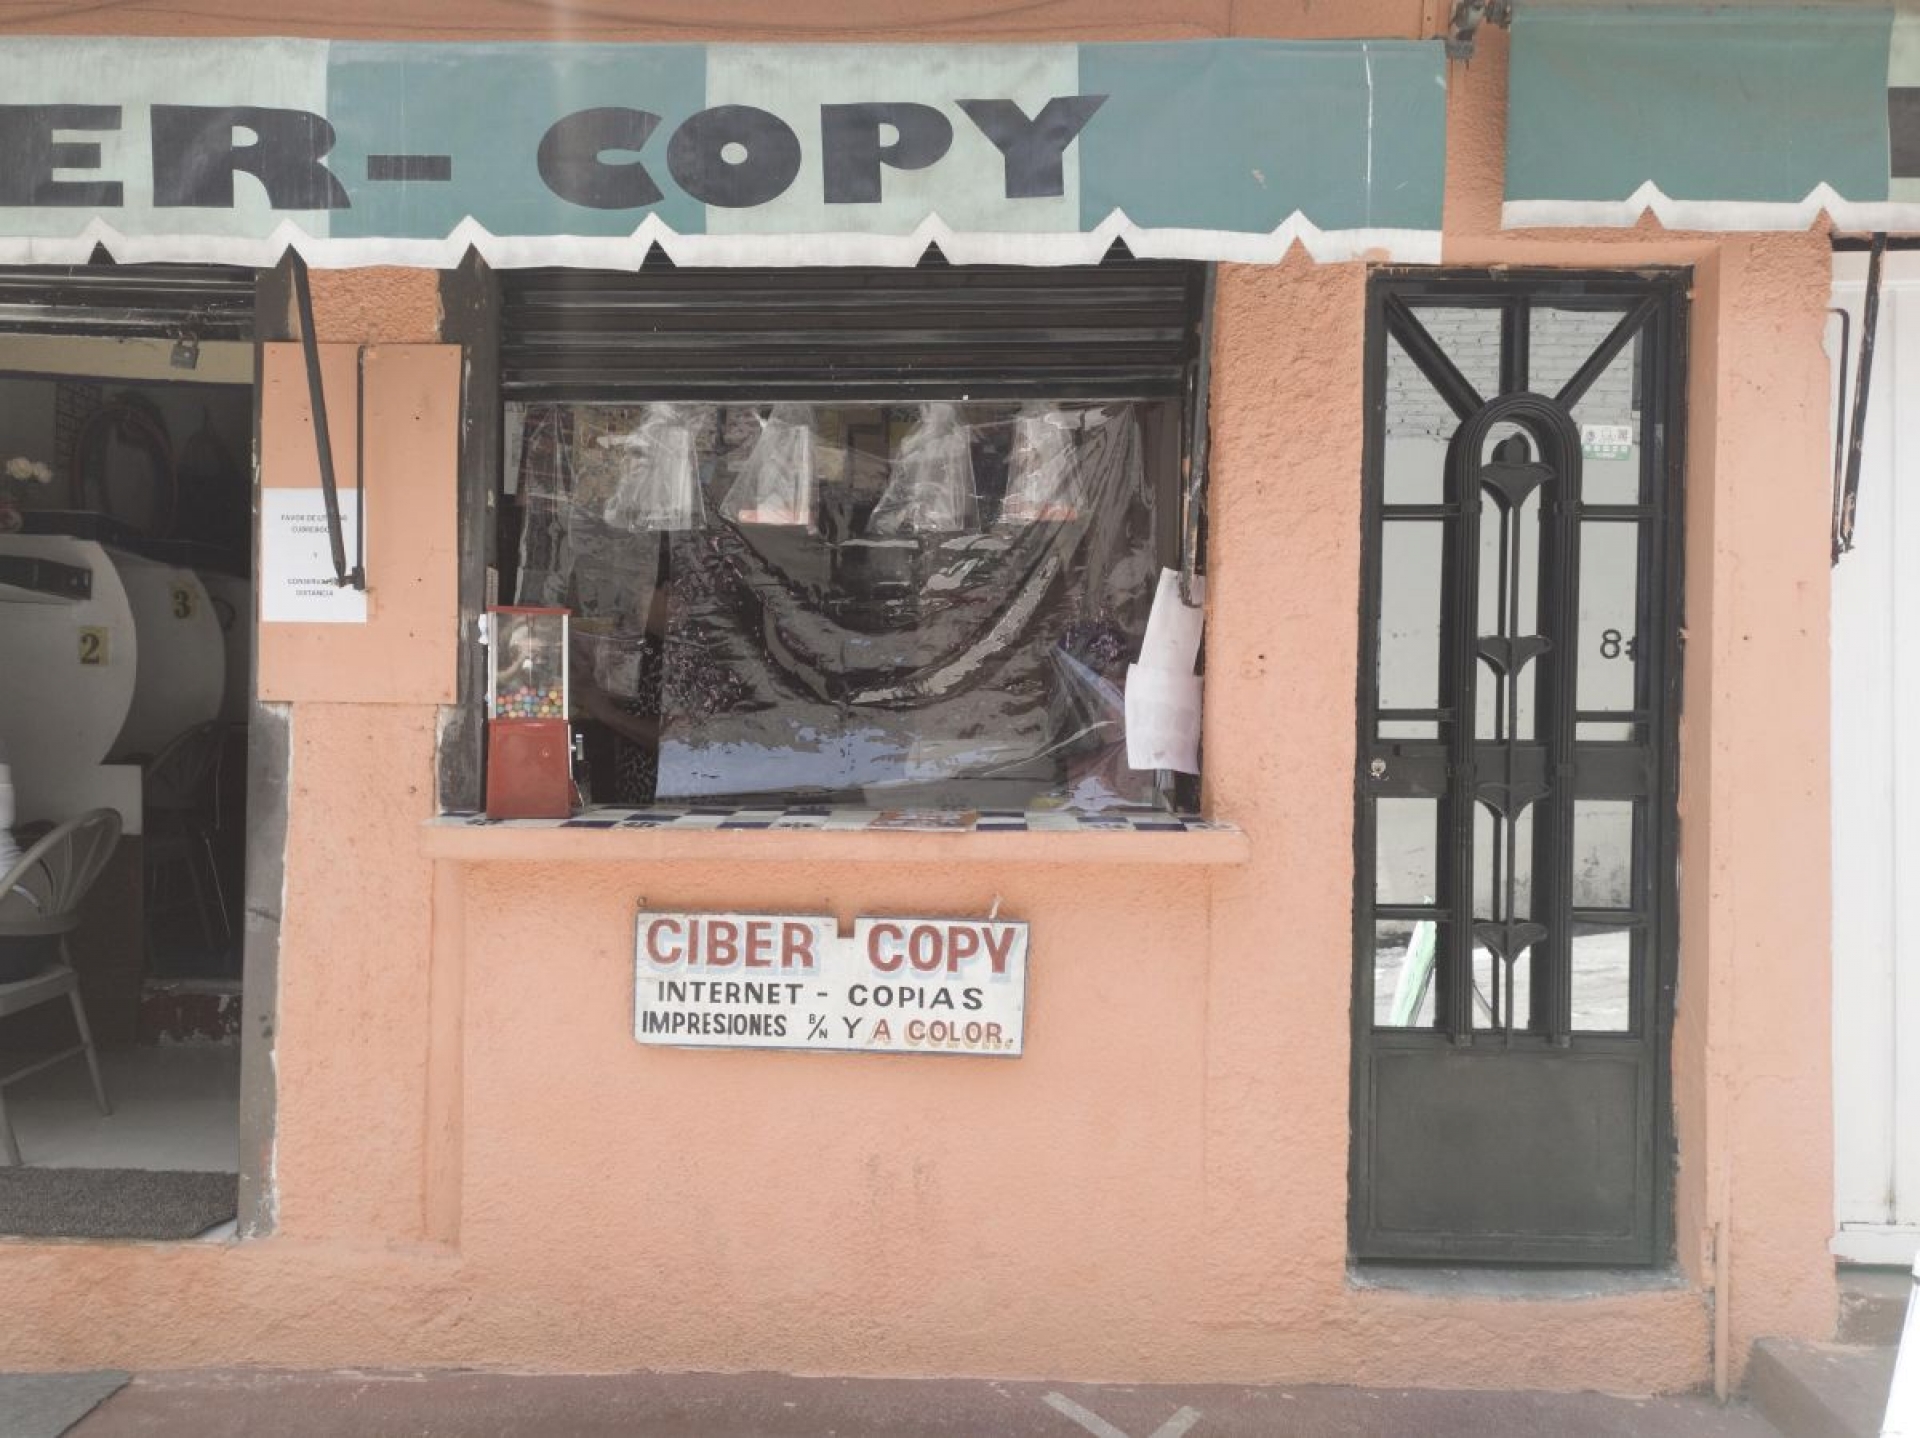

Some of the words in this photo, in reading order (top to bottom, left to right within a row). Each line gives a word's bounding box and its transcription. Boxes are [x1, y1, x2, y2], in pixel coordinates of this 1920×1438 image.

[537, 94, 1110, 210] COPY
[173, 589, 191, 619] 3
[80, 633, 100, 665] 2
[646, 918, 816, 972] CIBER
[867, 922, 1016, 977] COPY
[658, 980, 804, 1005] INTERNET
[848, 983, 984, 1010] COPIAS
[641, 1010, 788, 1038] IMPRESIONES
[842, 1016, 863, 1040] Y
[869, 1017, 893, 1042] A
